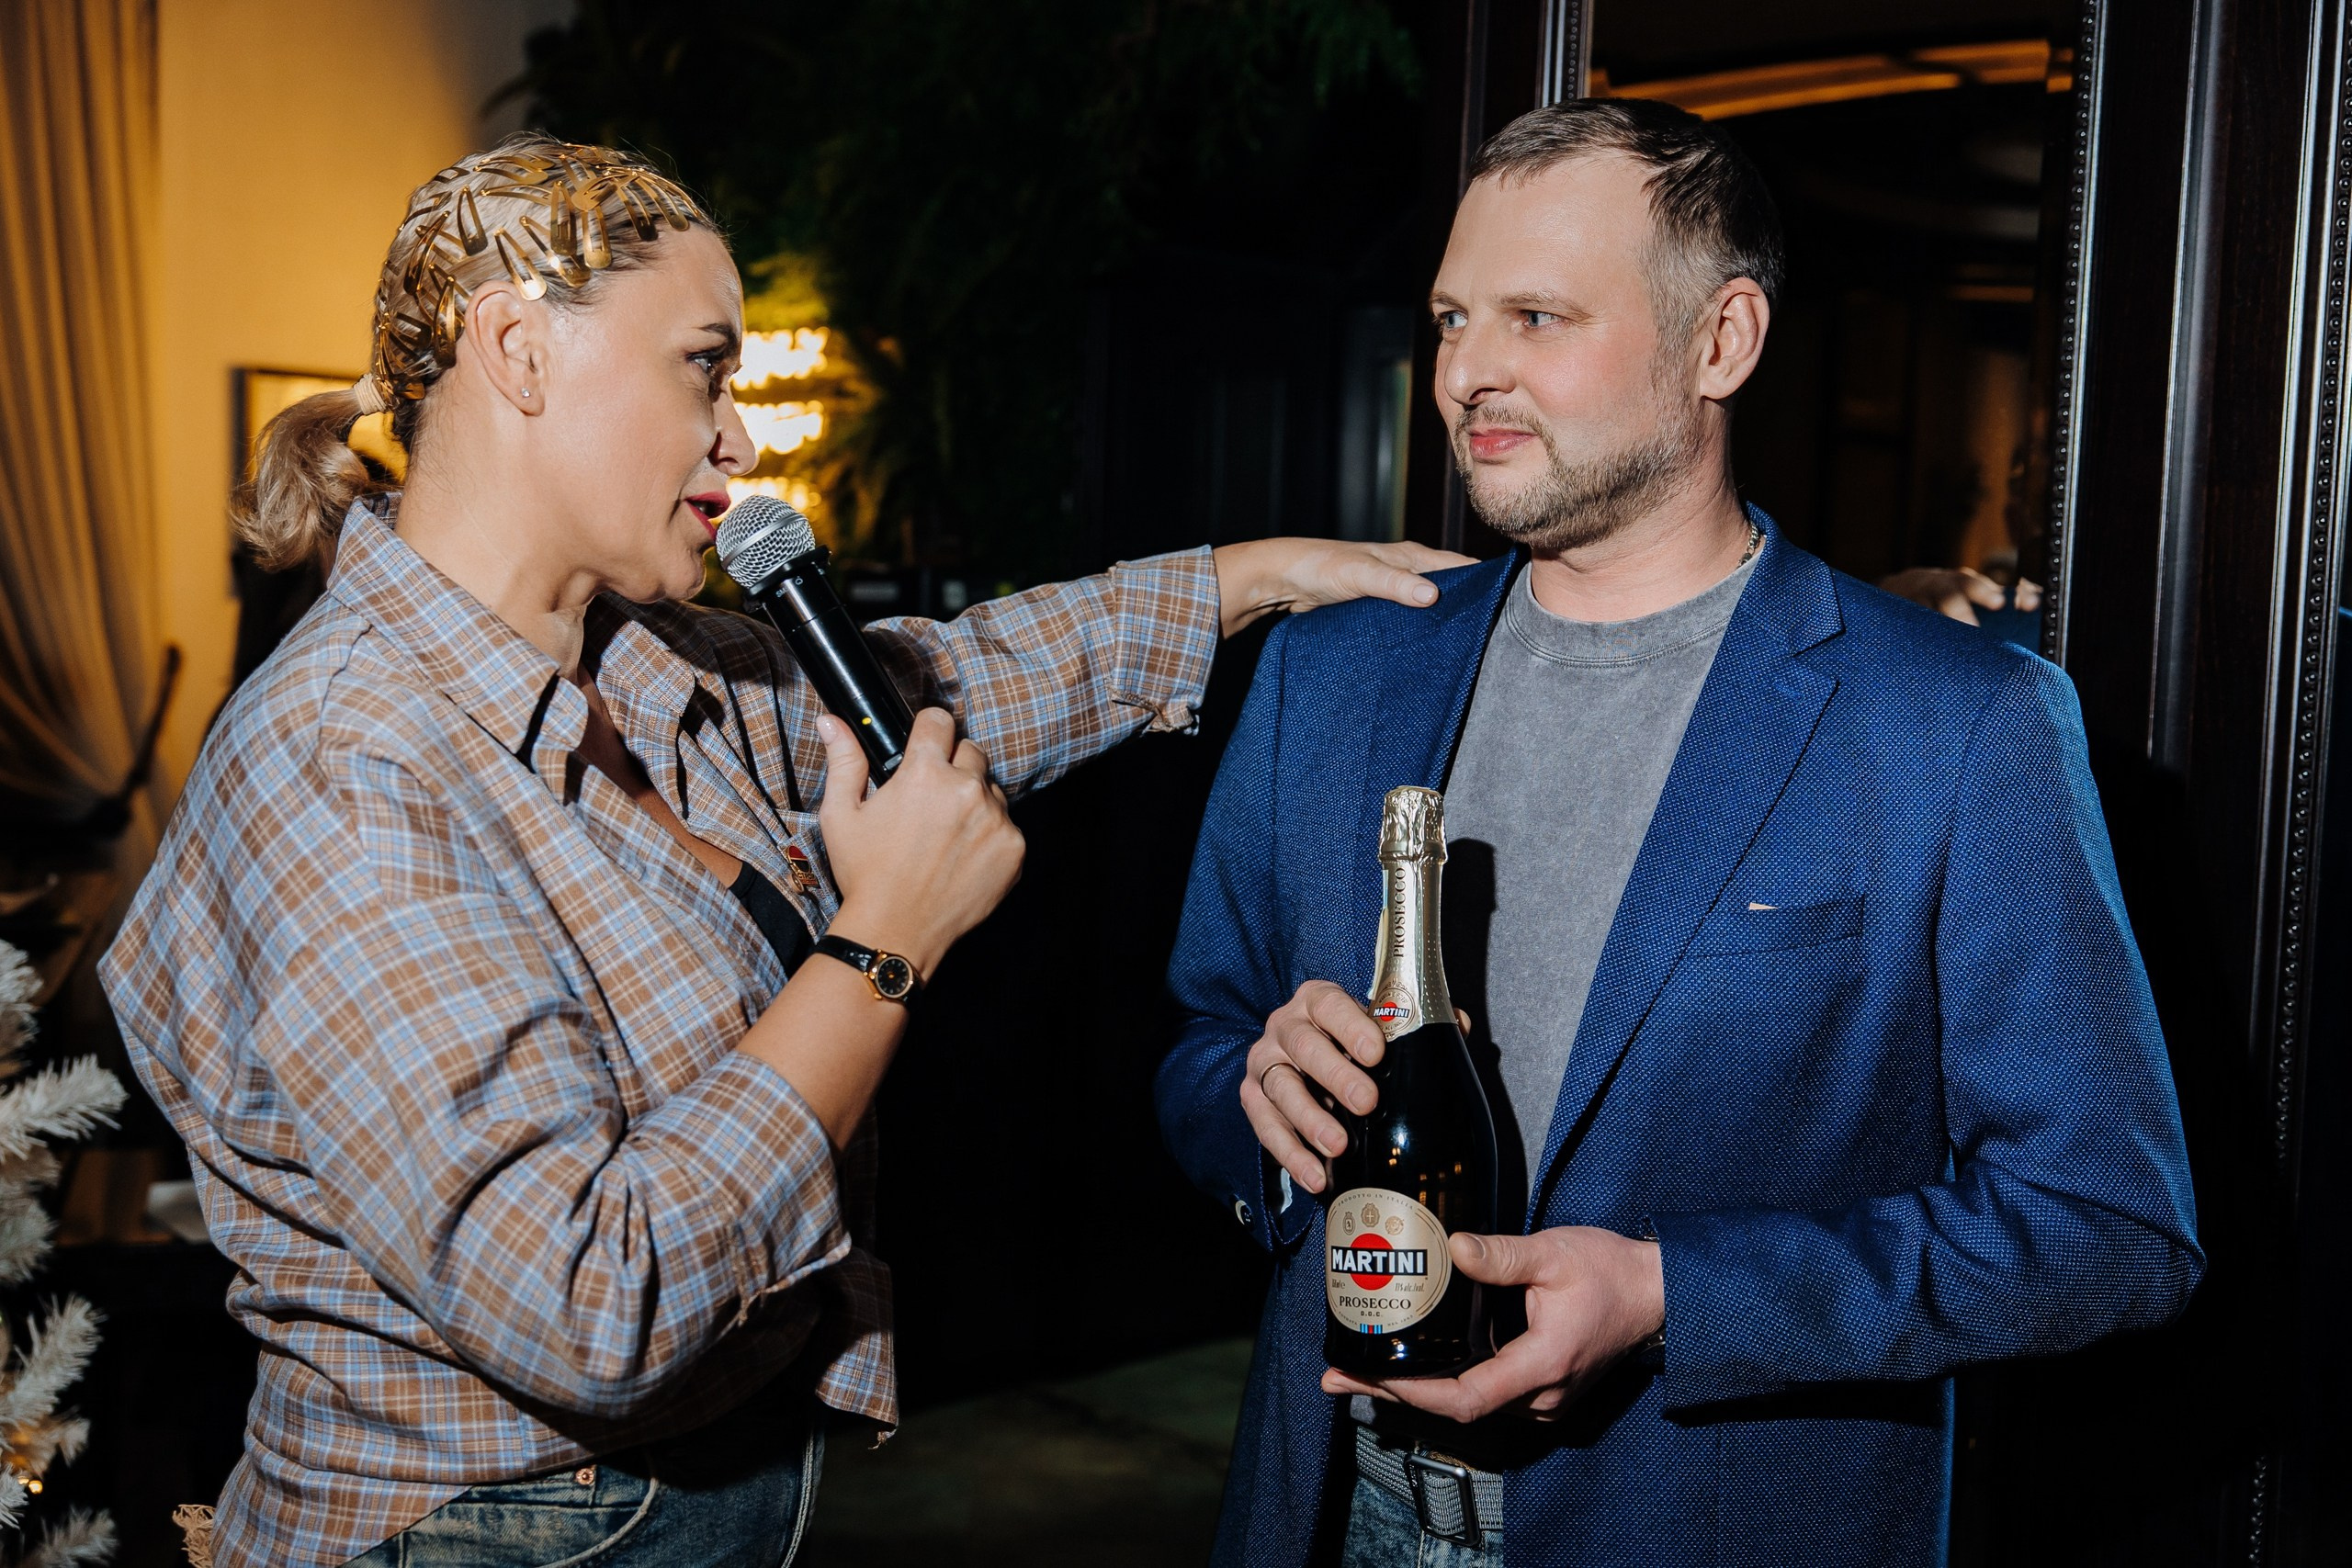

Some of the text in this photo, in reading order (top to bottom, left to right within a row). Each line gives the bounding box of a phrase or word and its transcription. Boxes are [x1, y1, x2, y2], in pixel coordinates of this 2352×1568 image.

[1394, 868, 1406, 957] PROSECCO
[1374, 1008, 1409, 1018] MARTINI
[1332, 1249, 1423, 1273] MARTINI
[1339, 1295, 1411, 1310] PROSECCO
